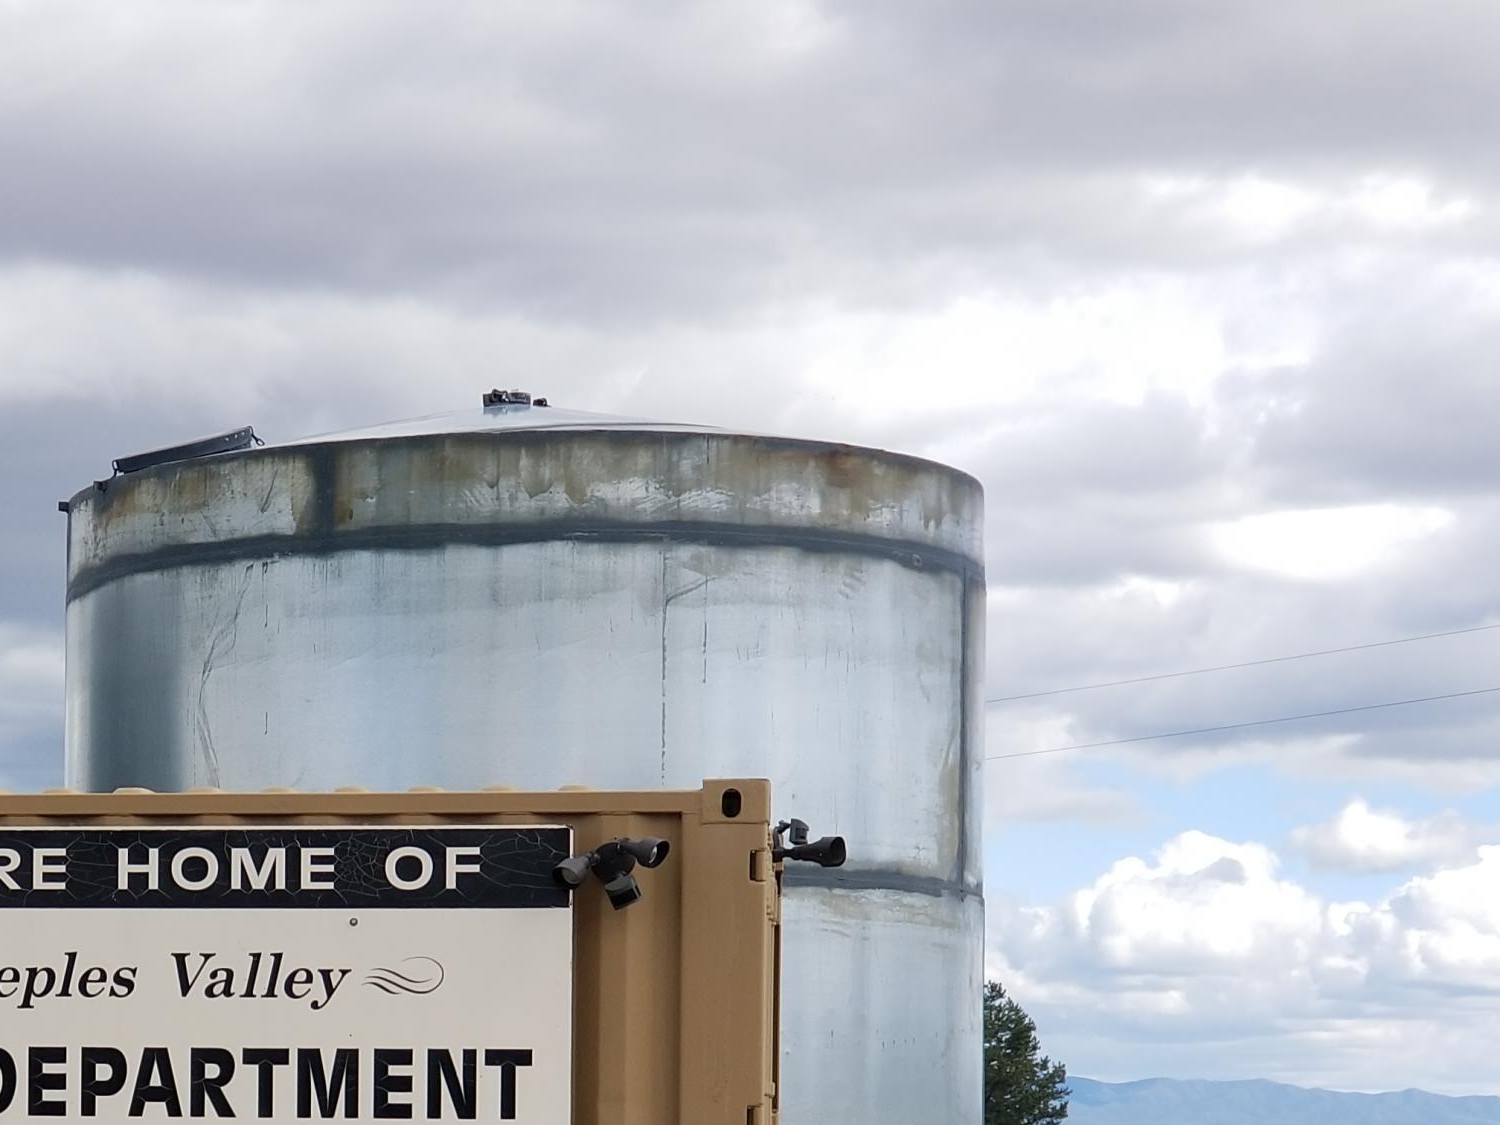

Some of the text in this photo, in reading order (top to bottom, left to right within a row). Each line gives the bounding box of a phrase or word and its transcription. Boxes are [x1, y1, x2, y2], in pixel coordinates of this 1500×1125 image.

[116, 846, 336, 891] HOME
[384, 846, 483, 891] OF
[171, 952, 352, 1010] Valley
